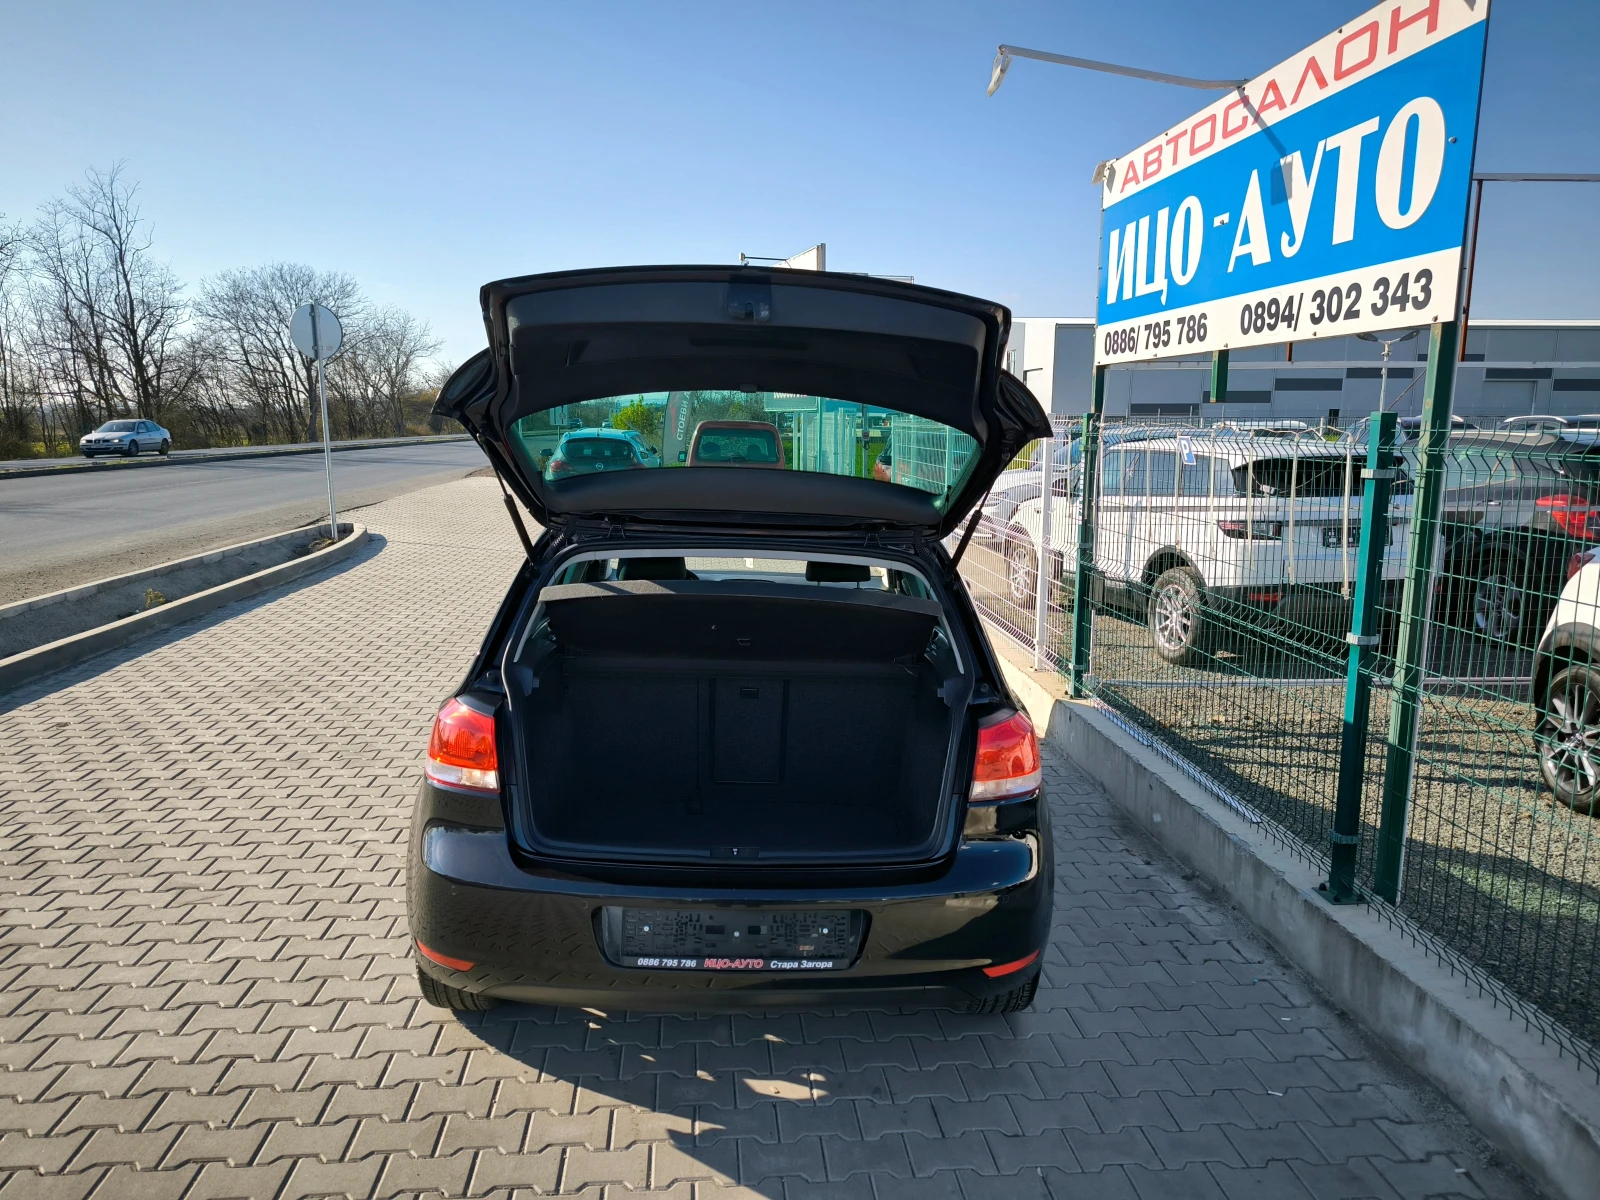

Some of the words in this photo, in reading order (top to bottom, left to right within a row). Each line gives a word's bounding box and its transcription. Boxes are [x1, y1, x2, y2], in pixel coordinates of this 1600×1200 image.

[1119, 0, 1440, 194] АВТОСАЛОН
[1104, 325, 1141, 356] 0886/
[1144, 319, 1171, 350] 795
[1176, 312, 1208, 345] 786
[1240, 292, 1304, 336] 0894/
[1309, 282, 1363, 326] 302
[1370, 268, 1433, 317] 343
[676, 401, 689, 441] СТОЕВИ
[1180, 439, 1190, 461] P
[637, 957, 660, 967] 0886
[661, 958, 679, 968] 795
[680, 959, 698, 968] 786
[703, 958, 764, 970] ИЦО-АУТО
[770, 960, 799, 970] Стара
[800, 959, 834, 970] Загора
